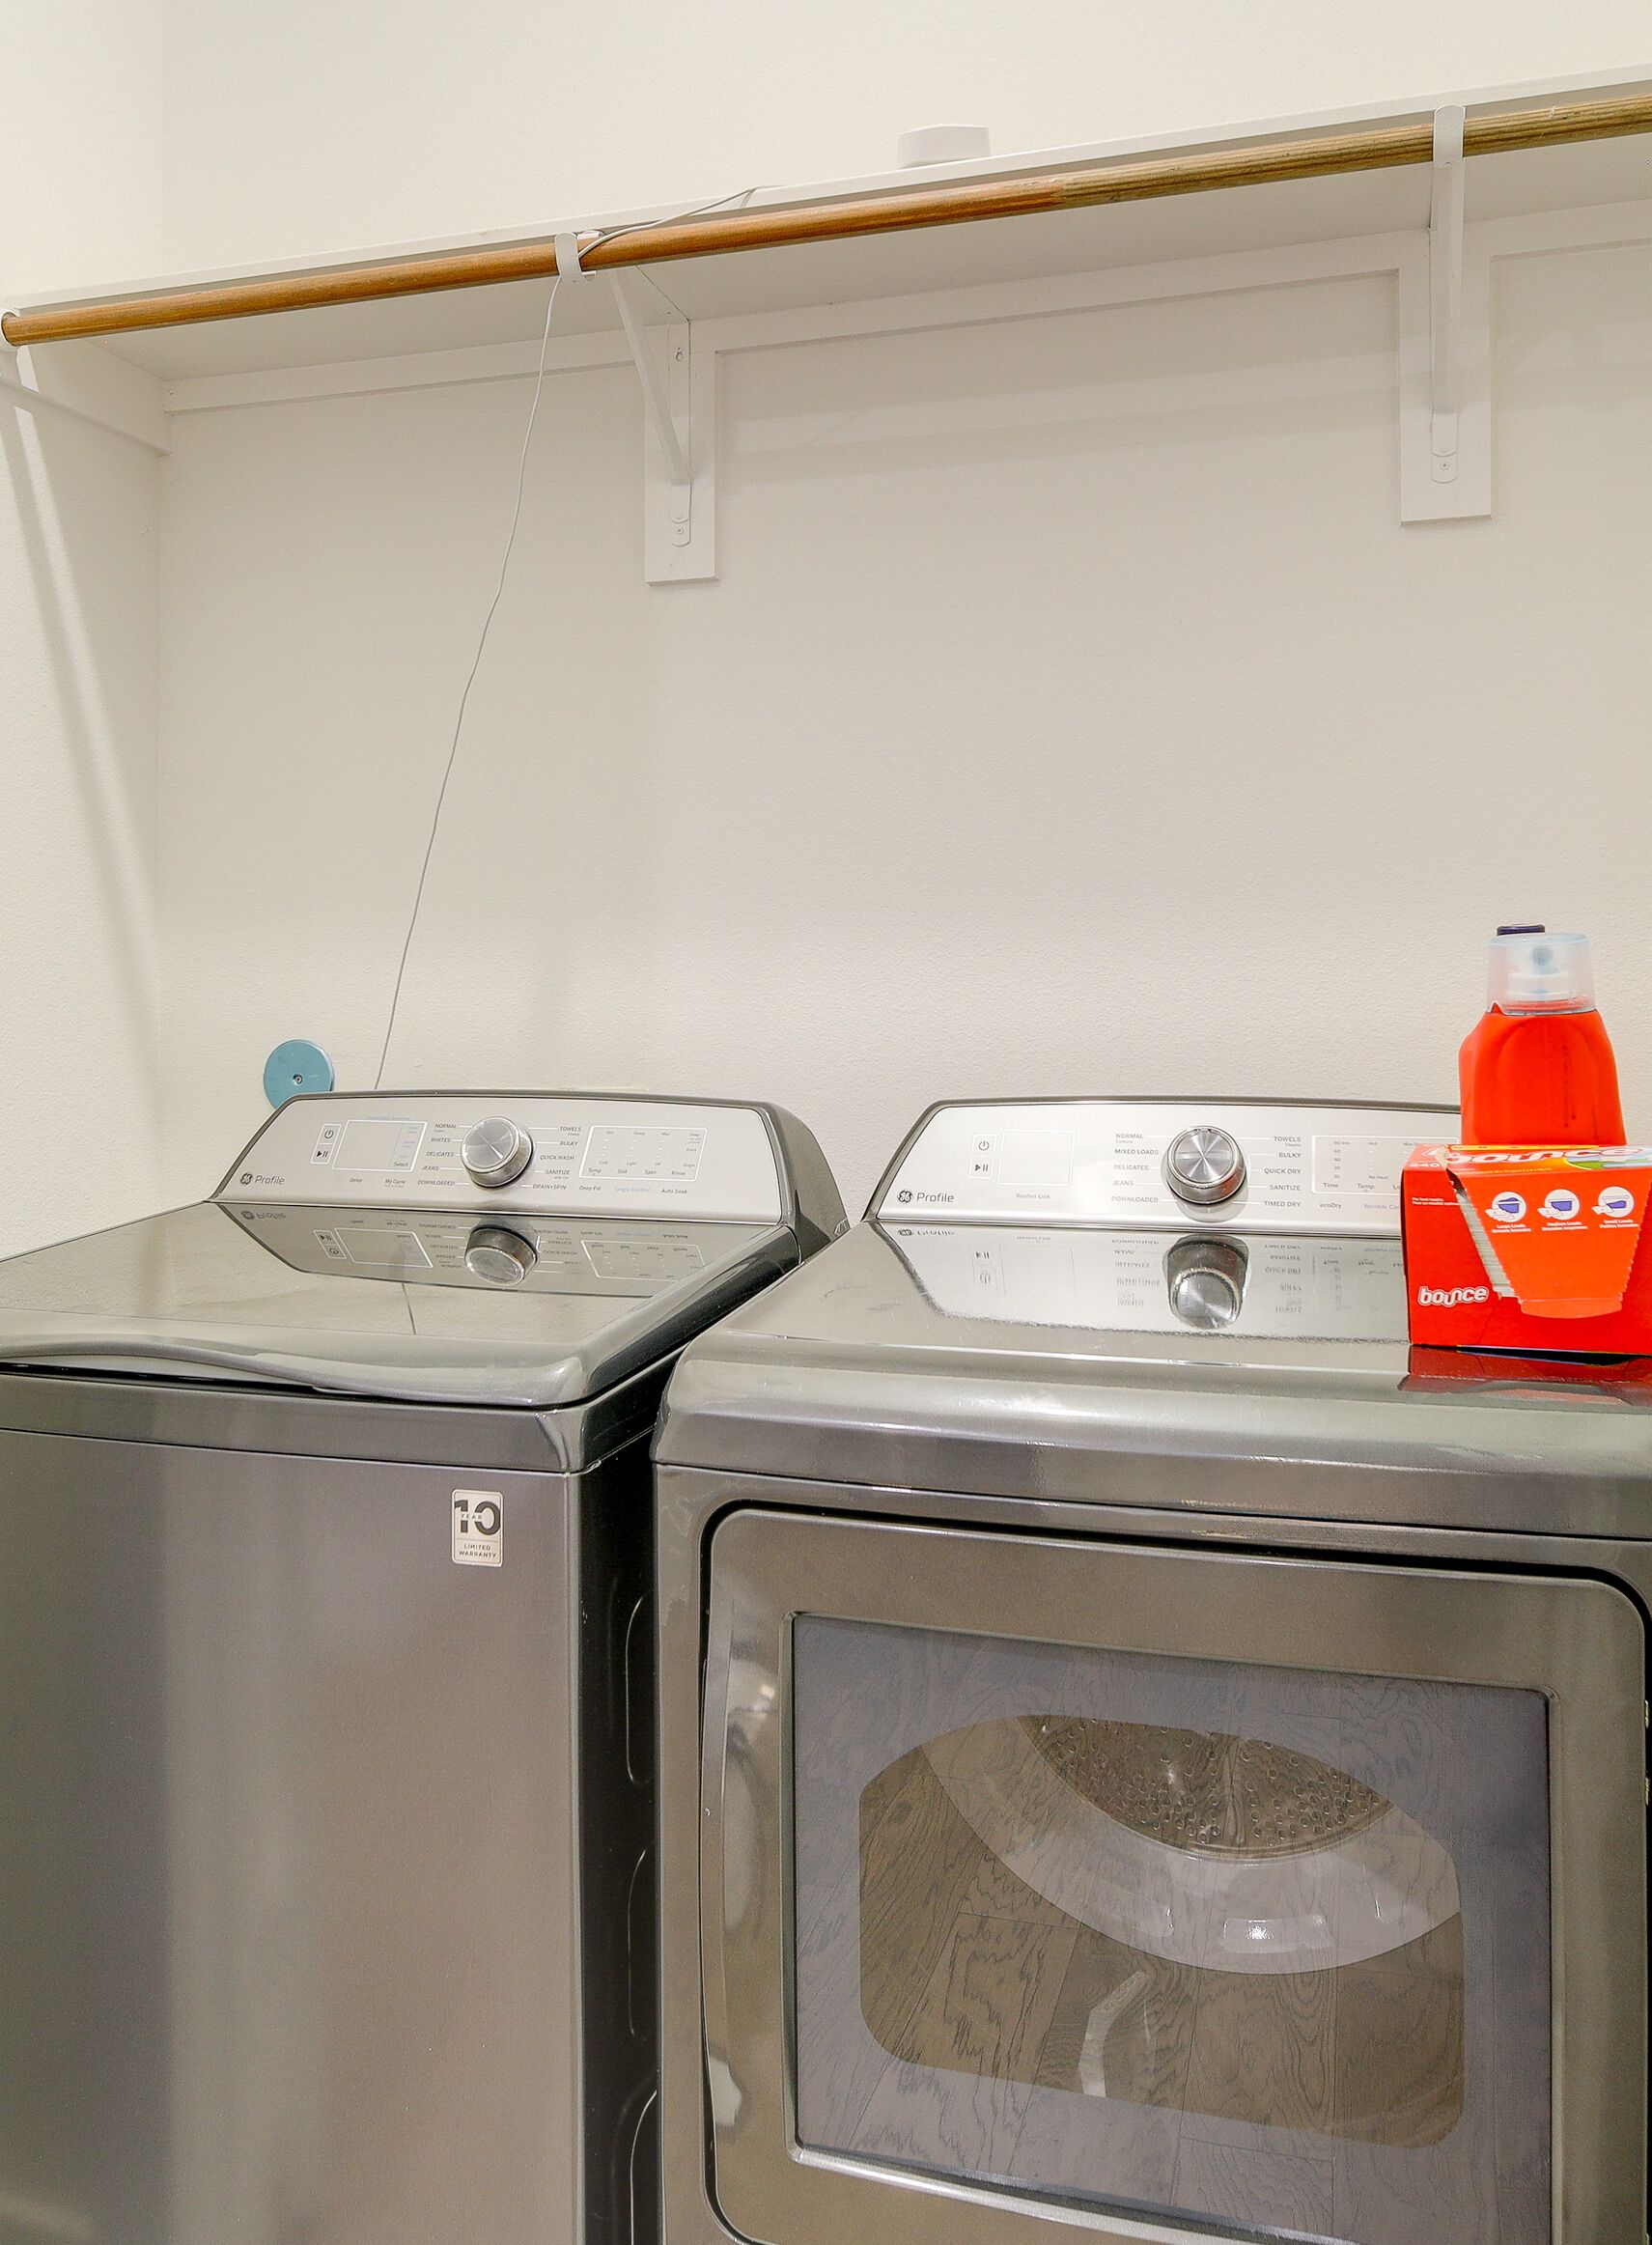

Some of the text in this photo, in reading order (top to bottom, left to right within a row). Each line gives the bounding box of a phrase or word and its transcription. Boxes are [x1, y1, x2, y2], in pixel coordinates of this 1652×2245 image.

[254, 1175, 286, 1186] Profile
[916, 1193, 955, 1203] Profile
[1417, 1286, 1489, 1307] bounce
[455, 1500, 501, 1536] 10
[459, 1550, 497, 1558] WARRANTY
